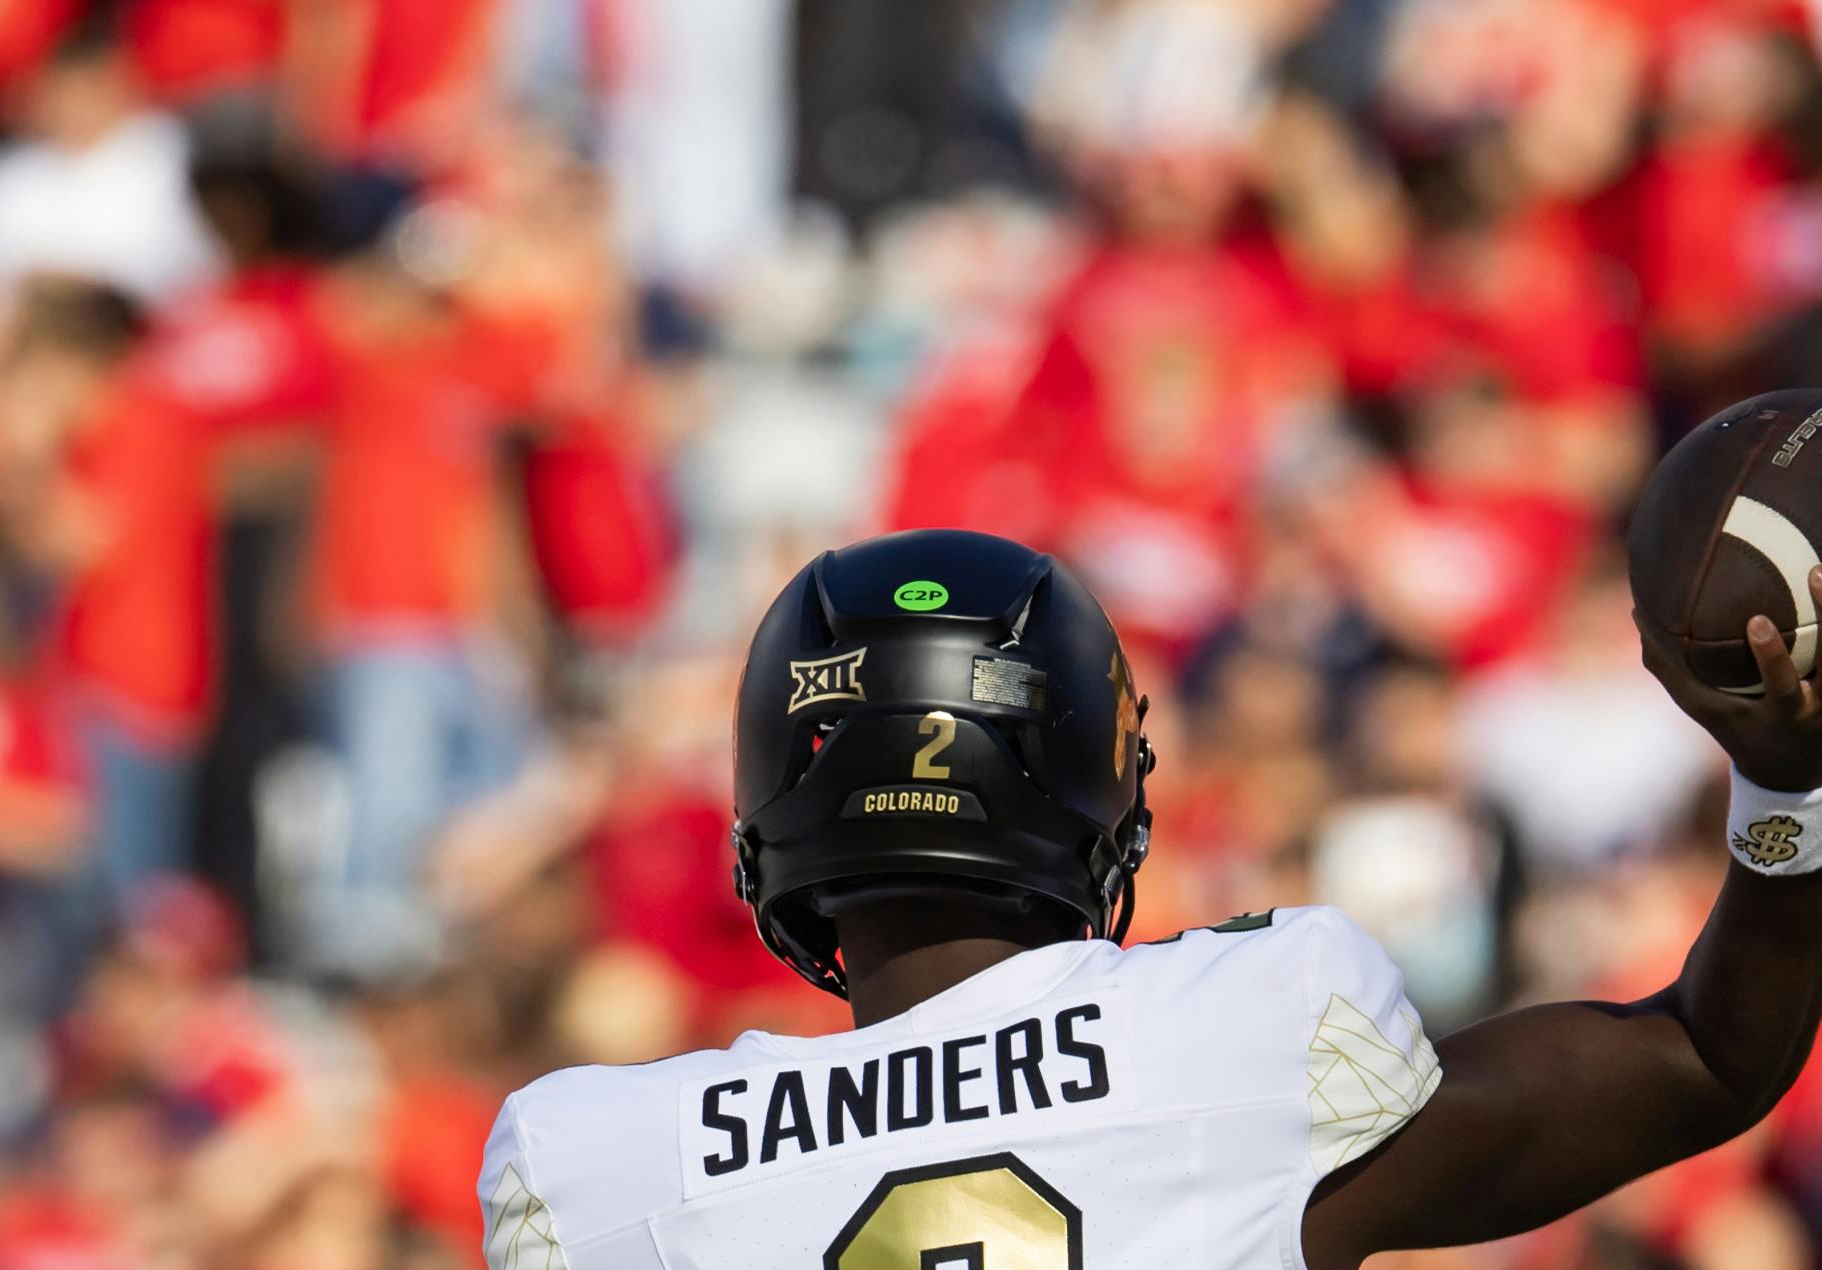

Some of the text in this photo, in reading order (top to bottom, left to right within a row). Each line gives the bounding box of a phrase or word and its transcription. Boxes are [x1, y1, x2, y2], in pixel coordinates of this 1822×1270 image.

[898, 589, 944, 602] C2P
[912, 710, 957, 779] 2
[864, 792, 959, 814] COLORADO
[701, 1002, 1110, 1176] SANDERS
